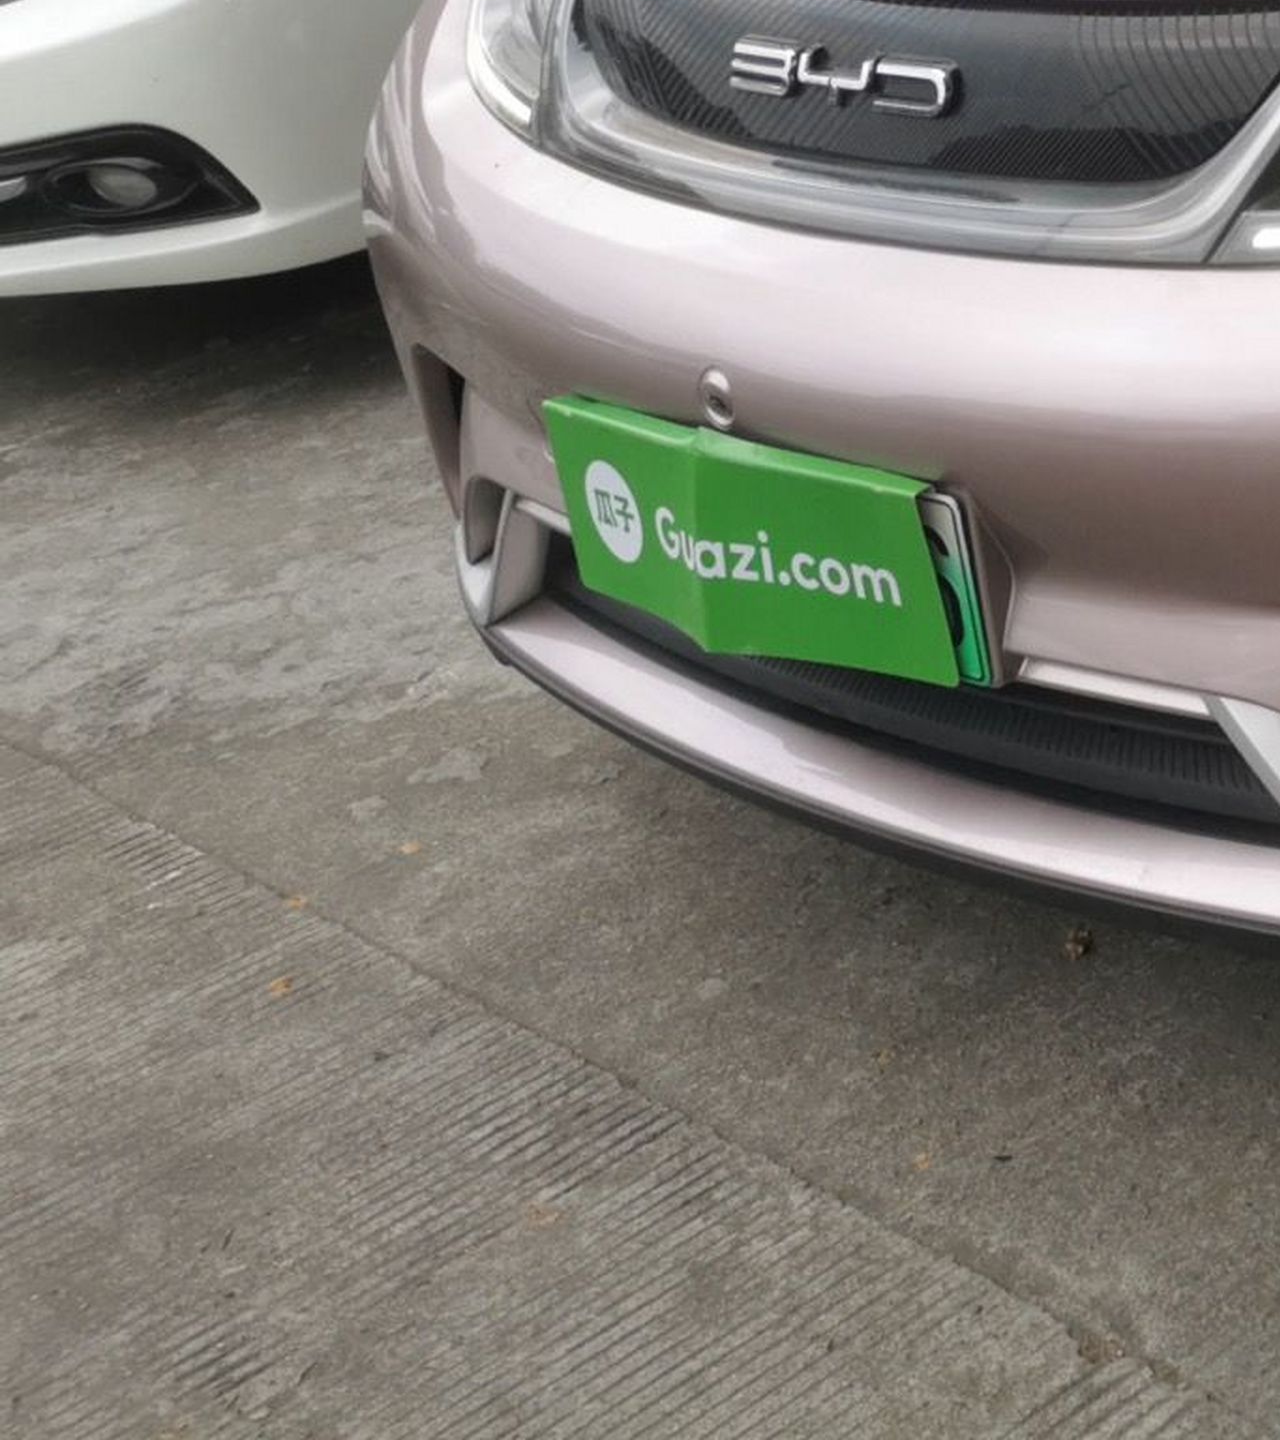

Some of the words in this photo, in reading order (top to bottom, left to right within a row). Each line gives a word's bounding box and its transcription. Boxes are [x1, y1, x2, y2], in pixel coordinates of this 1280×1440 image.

[730, 35, 962, 118] BYD
[593, 487, 635, 534] 瓜子
[655, 506, 902, 607] Guazi.com
